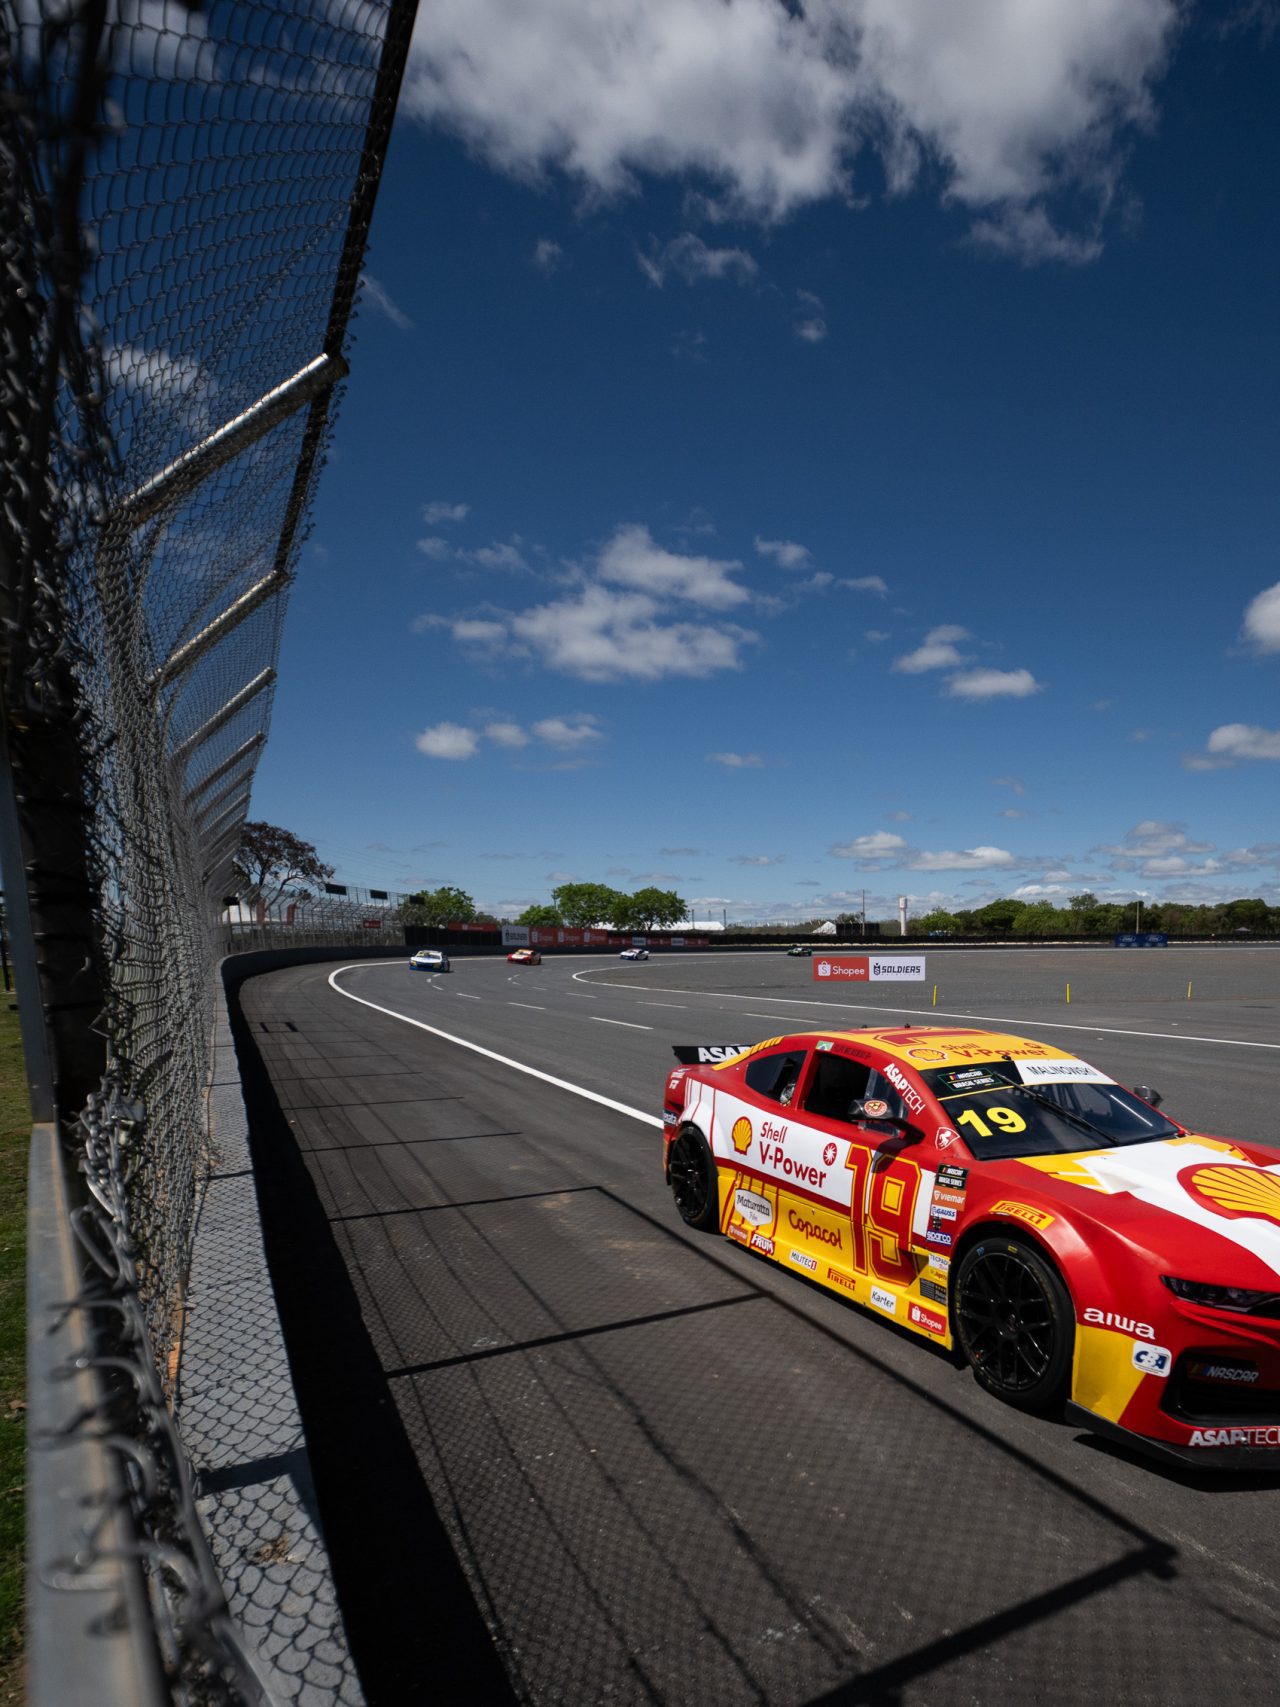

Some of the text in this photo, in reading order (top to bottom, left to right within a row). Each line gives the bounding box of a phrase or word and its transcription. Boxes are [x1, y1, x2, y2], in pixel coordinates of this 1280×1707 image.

[832, 966, 865, 977] Shopee
[882, 965, 921, 974] SOLDIERS
[941, 1042, 981, 1050] Shell
[952, 1048, 1048, 1058] V-Power
[883, 1062, 926, 1115] ASAPTECH
[760, 1121, 788, 1144] Shell
[957, 1106, 1027, 1138] 19
[759, 1141, 827, 1188] V-Power
[845, 1143, 922, 1287] 19
[936, 1208, 956, 1218] GAUSS
[995, 1202, 1047, 1225] PIRELLI
[788, 1209, 843, 1251] Copacol
[927, 1231, 952, 1243] sparco
[827, 1267, 857, 1292] PIRELLI
[871, 1290, 895, 1309] Karter
[920, 1313, 943, 1331] Shopee
[1083, 1307, 1156, 1341] aiwa
[1207, 1365, 1260, 1383] NASCAR
